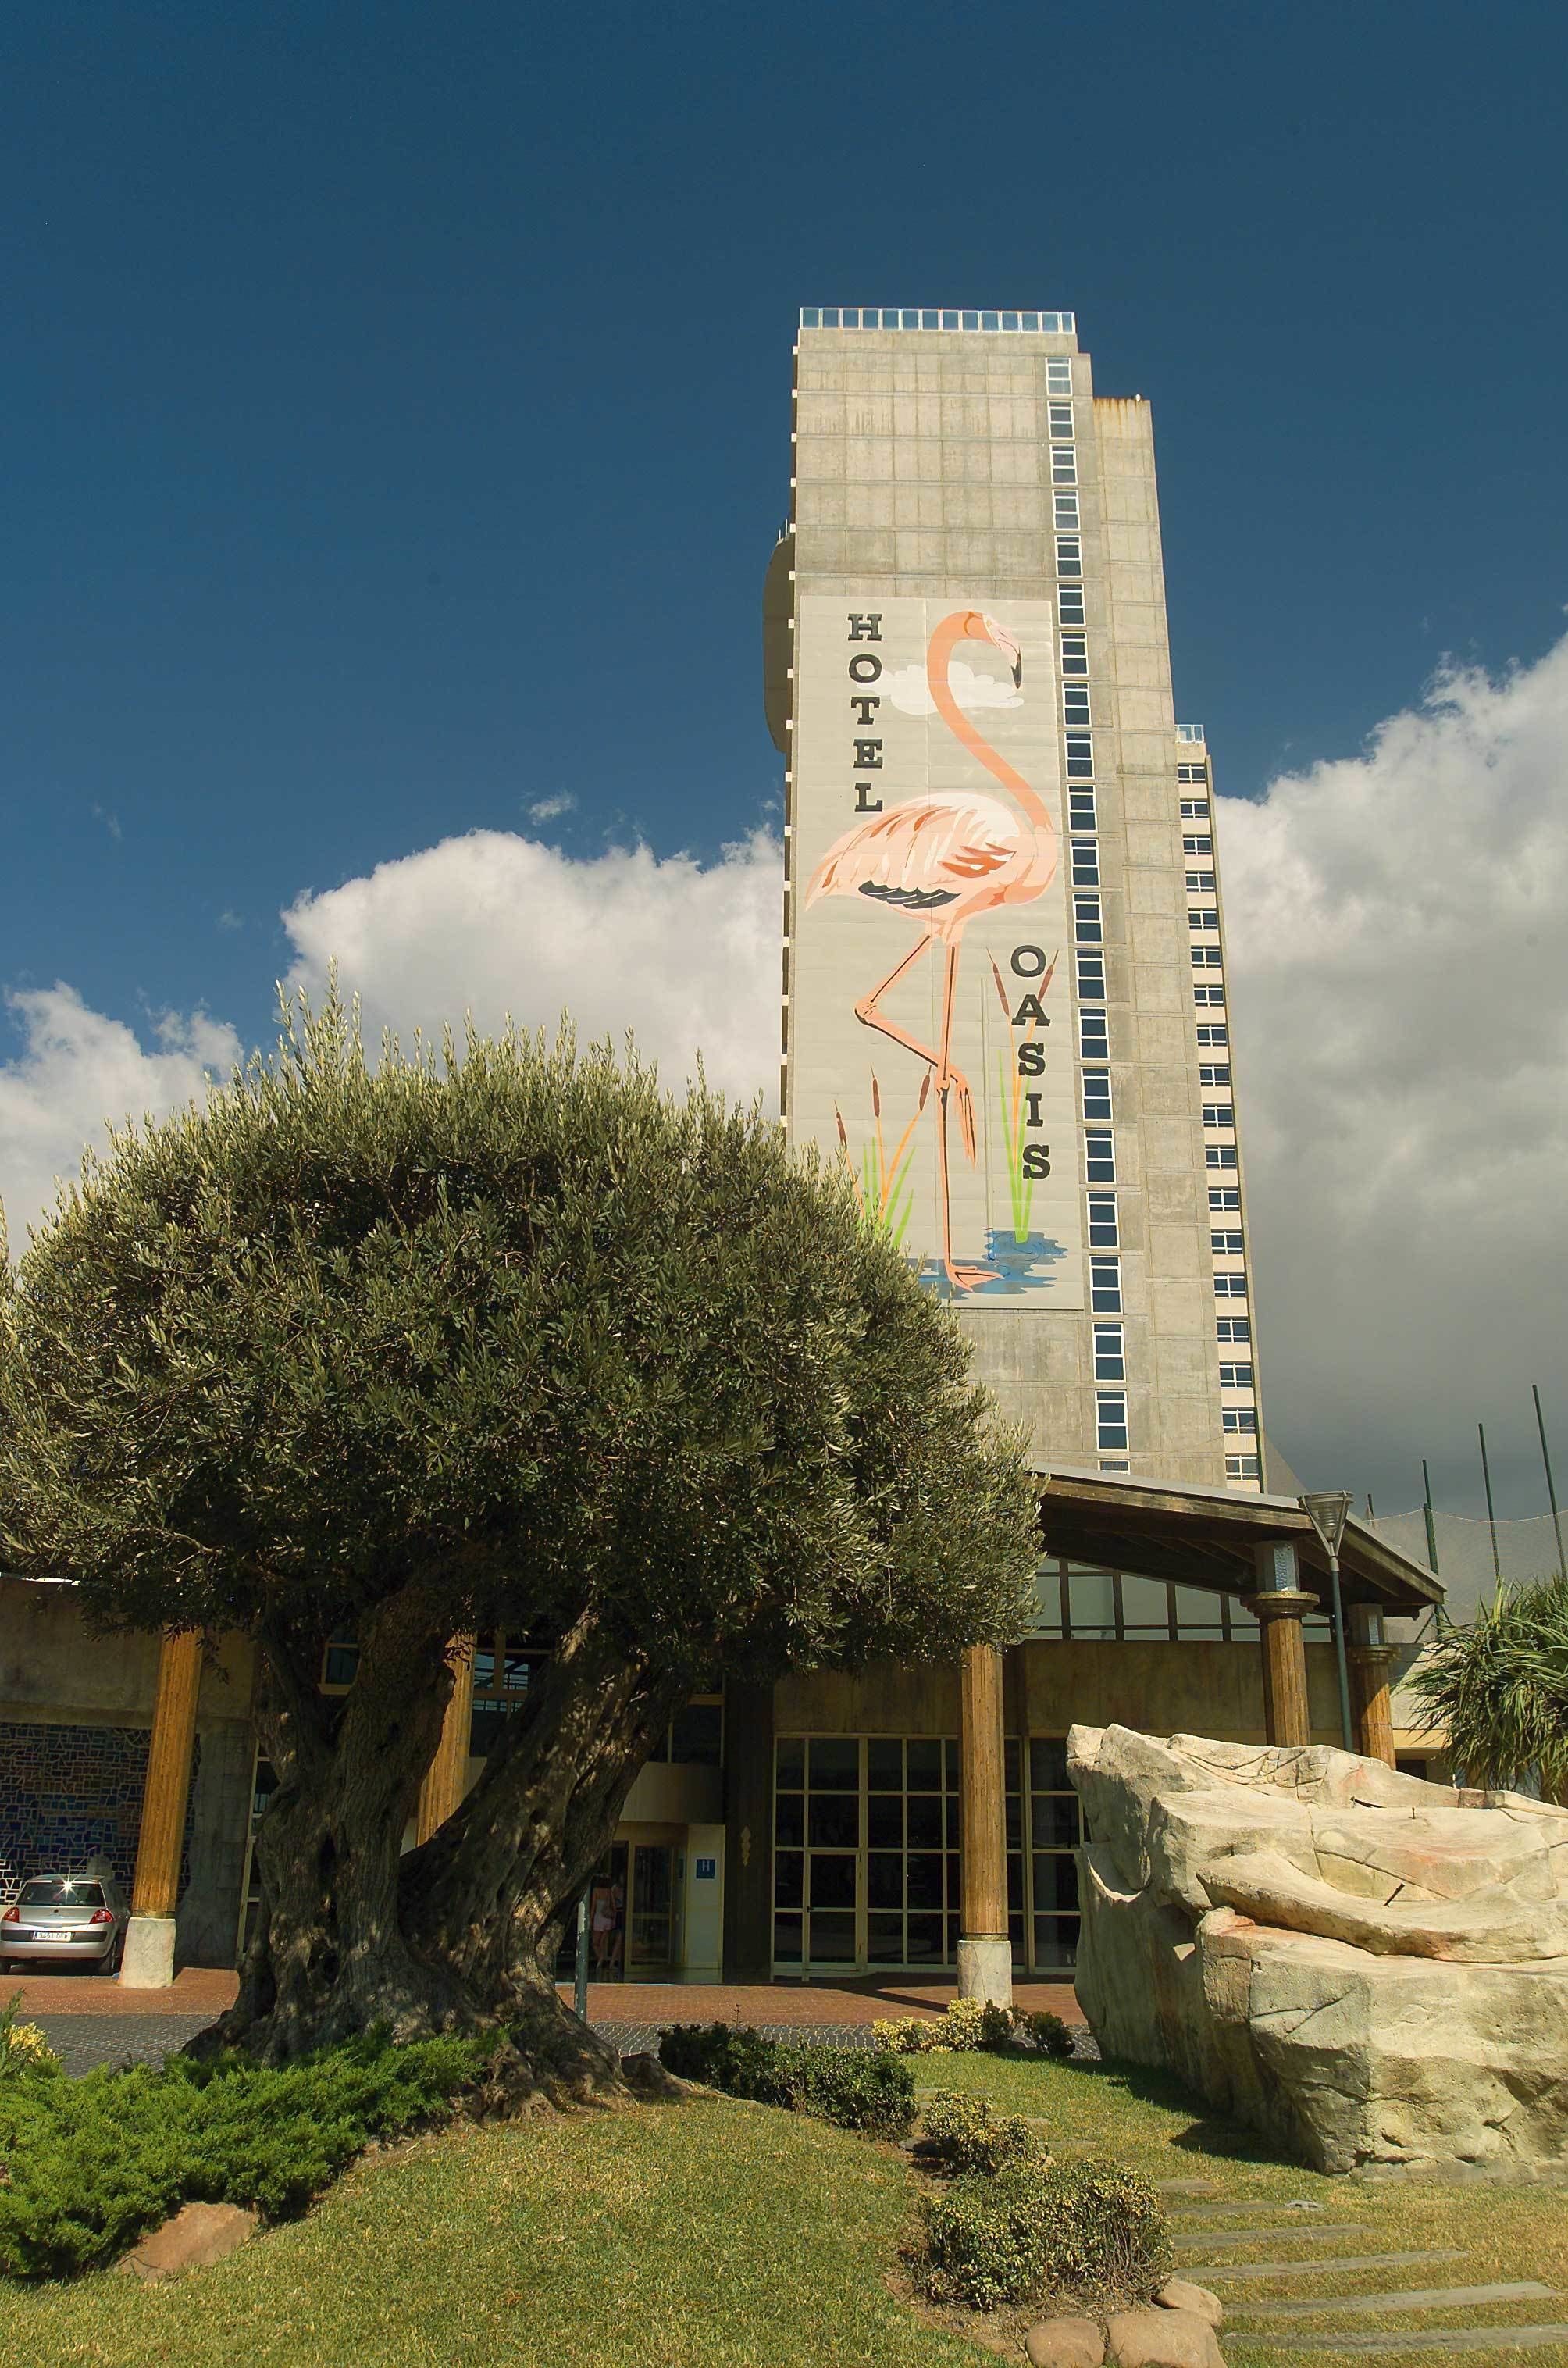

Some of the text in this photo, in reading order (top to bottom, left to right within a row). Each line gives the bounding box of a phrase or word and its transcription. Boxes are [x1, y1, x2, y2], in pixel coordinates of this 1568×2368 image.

[848, 613, 883, 812] HOTEL
[1010, 944, 1051, 1180] OASIS
[702, 1860, 710, 1872] H
